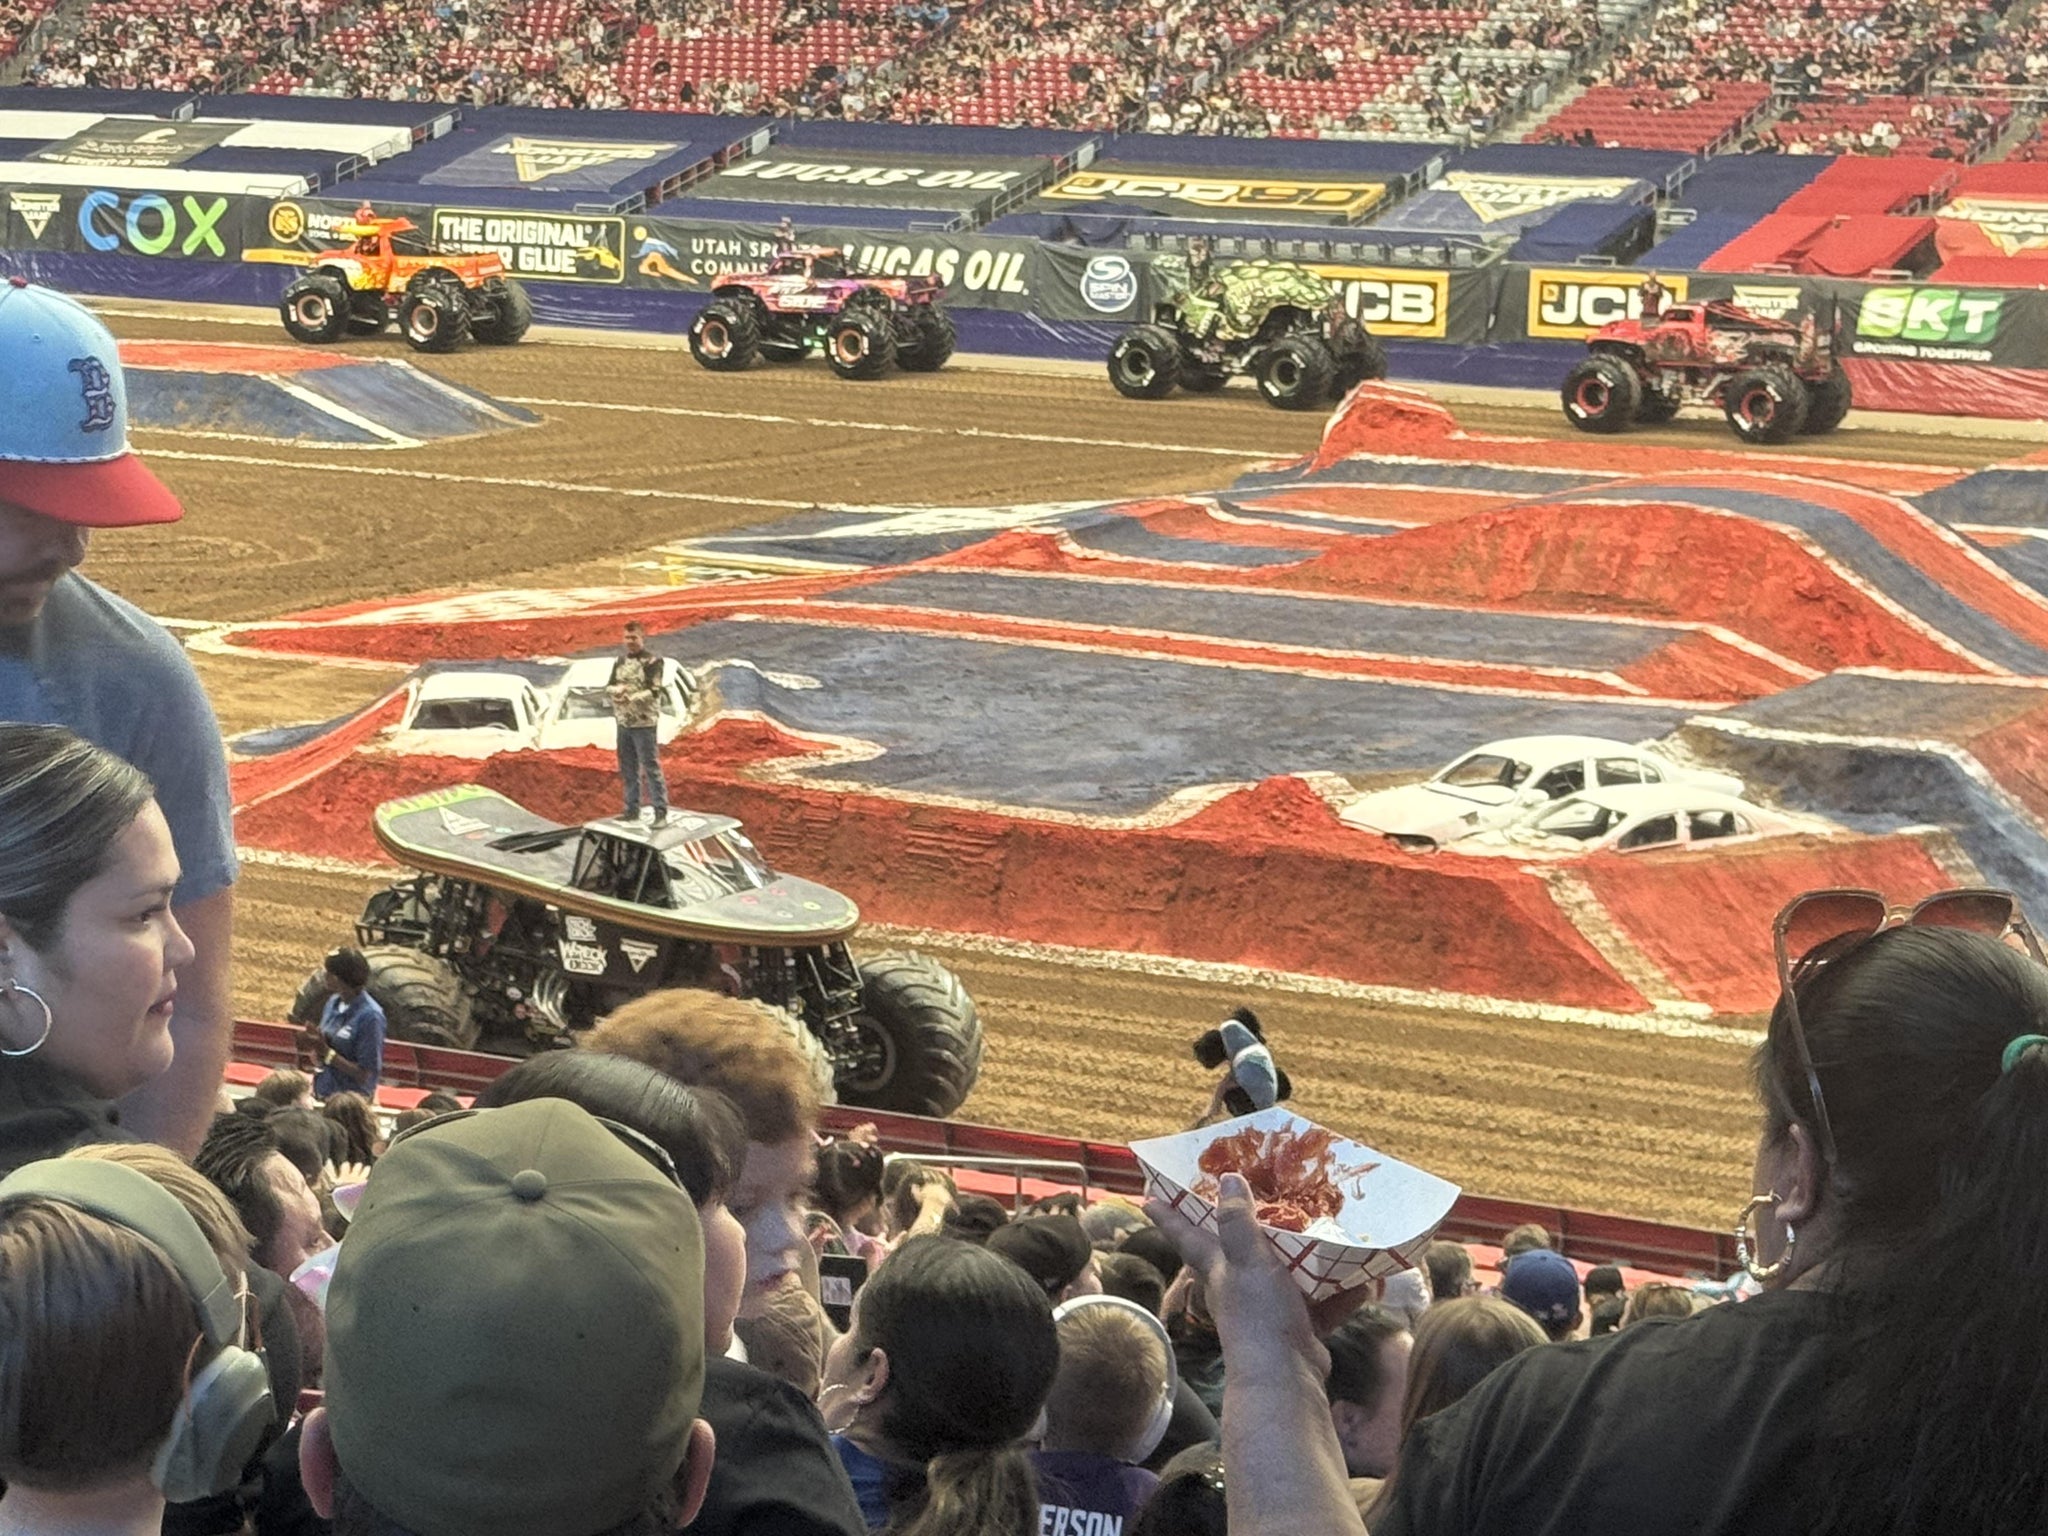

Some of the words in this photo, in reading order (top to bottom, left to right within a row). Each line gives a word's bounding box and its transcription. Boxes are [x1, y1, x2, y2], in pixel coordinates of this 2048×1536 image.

[720, 161, 924, 186] LUCAS
[917, 170, 1021, 189] OIL
[78, 190, 228, 258] COX
[439, 216, 483, 242] THE
[485, 219, 590, 248] ORIGINAL
[519, 246, 578, 274] GLUE
[691, 238, 741, 256] UTAH
[963, 250, 1026, 294] OIL
[1089, 282, 1129, 294] SPIN
[1332, 279, 1435, 324] CB
[1852, 341, 1918, 357] GROWING
[1919, 345, 1993, 362] TOGETHER
